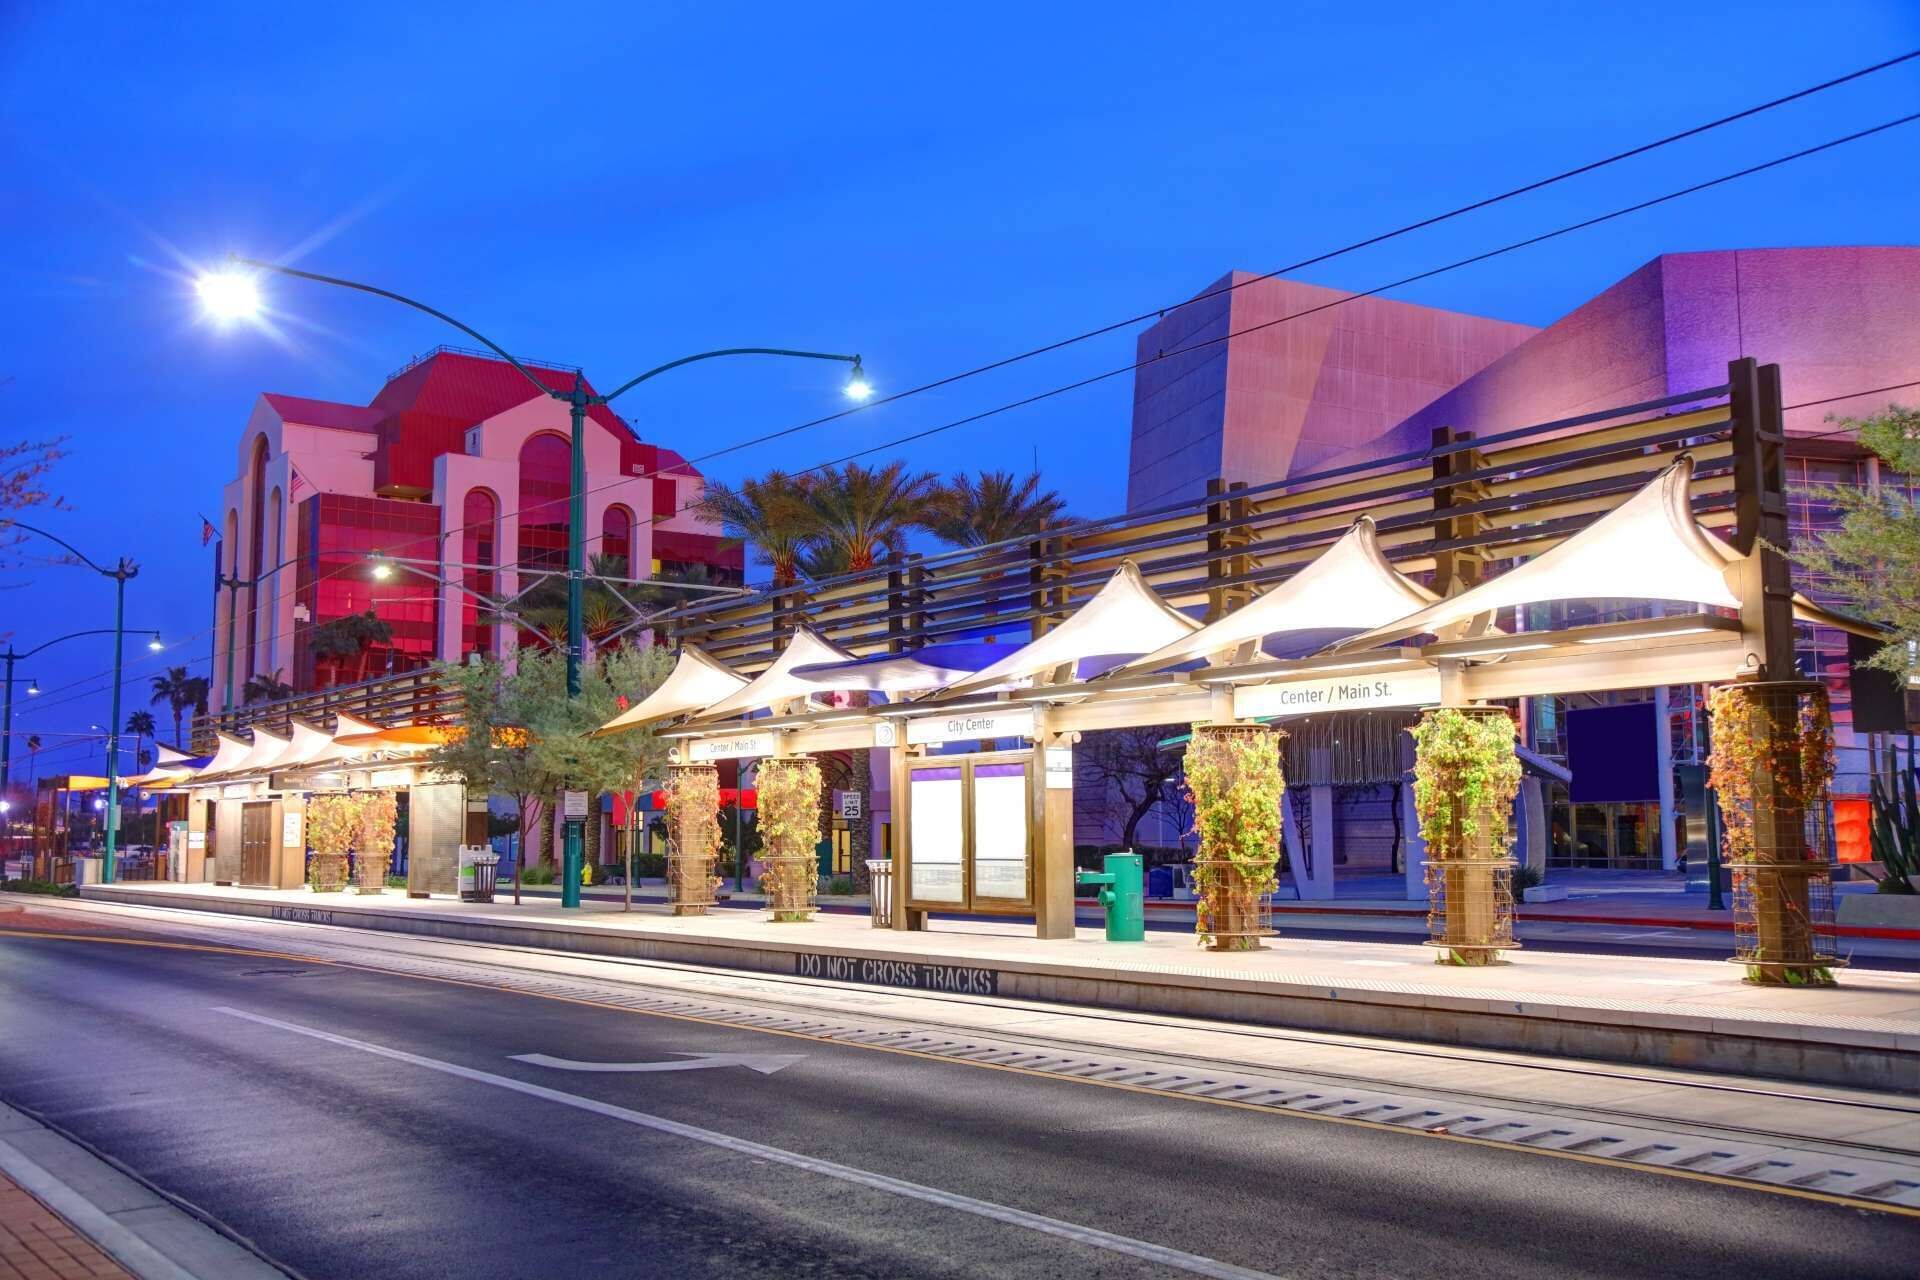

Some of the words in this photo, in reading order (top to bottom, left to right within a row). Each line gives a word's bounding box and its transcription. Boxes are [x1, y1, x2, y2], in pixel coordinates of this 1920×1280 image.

[1280, 690, 1324, 705] Center
[1327, 685, 1334, 704] /
[1338, 683, 1370, 700] Main
[1375, 681, 1393, 697] St.
[947, 720, 964, 735] City
[966, 718, 995, 731] Center
[710, 743, 729, 753] Center
[735, 740, 749, 752] Main
[844, 806, 859, 816] 25
[800, 954, 821, 976] DO
[826, 955, 857, 981] NOT
[862, 958, 917, 987] CROSS
[923, 965, 992, 994] TRACKS
